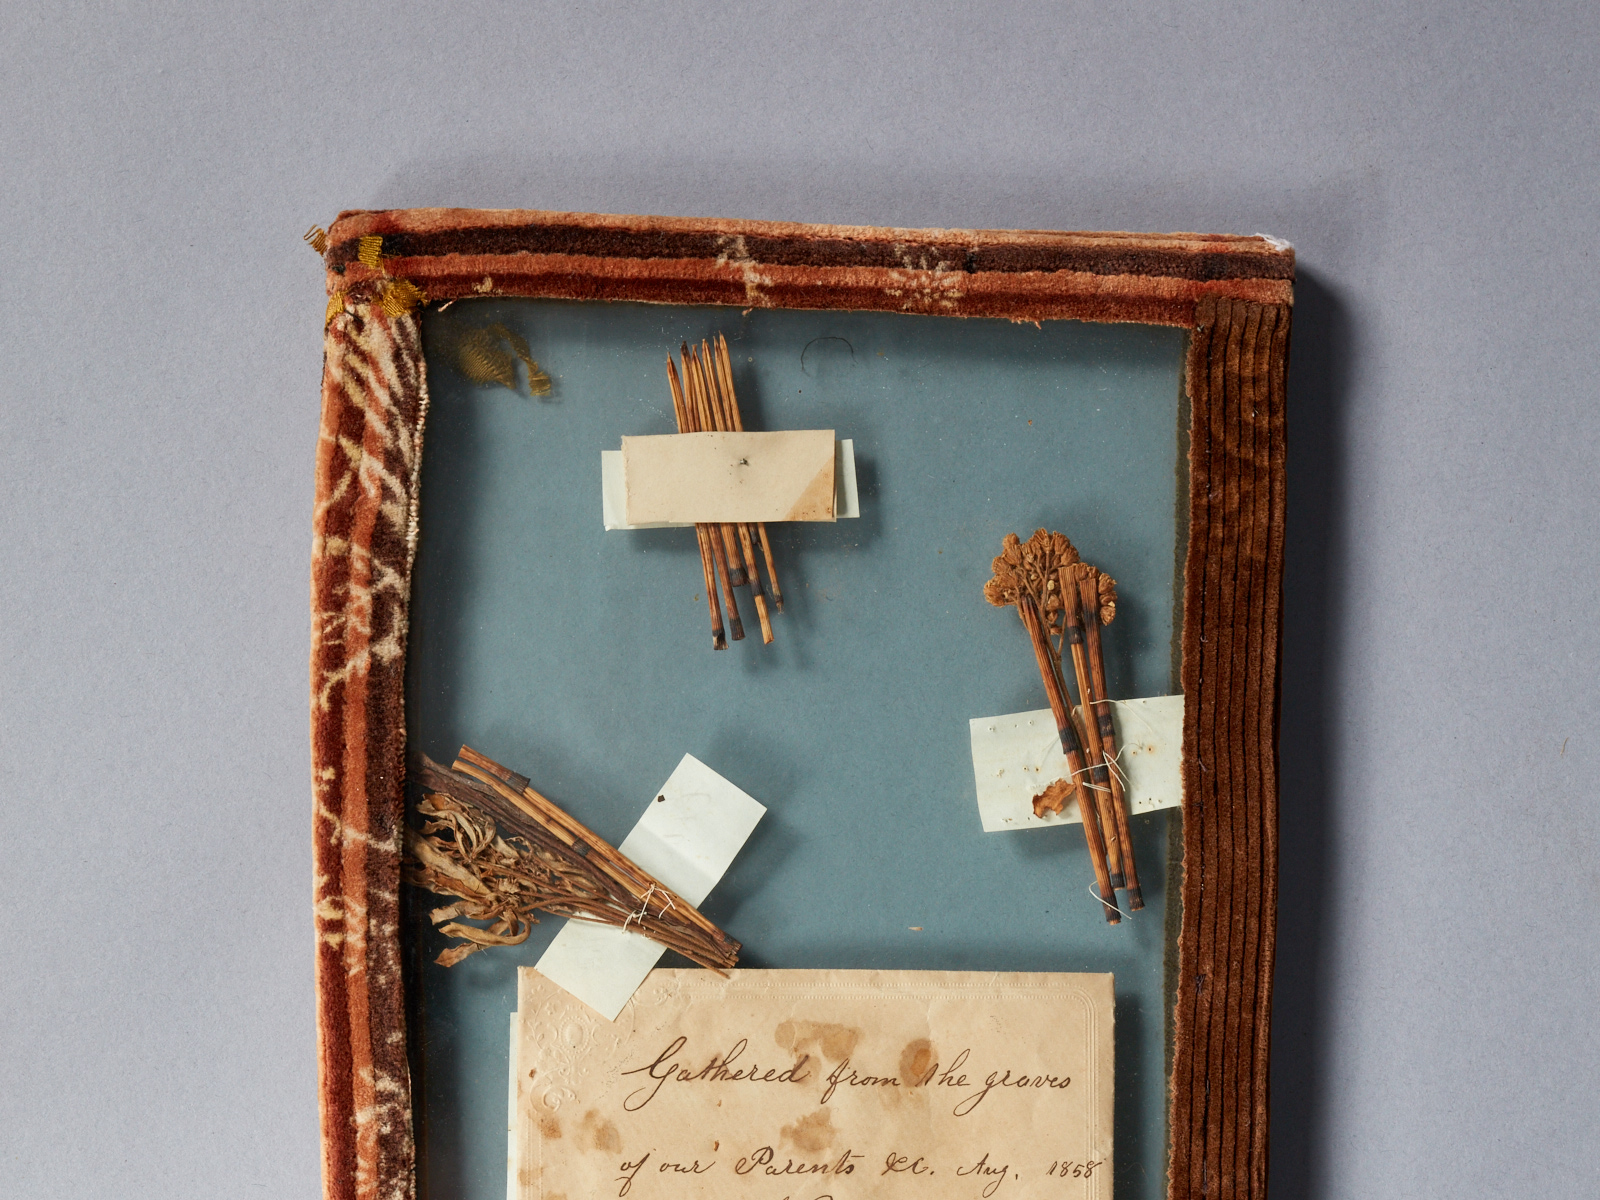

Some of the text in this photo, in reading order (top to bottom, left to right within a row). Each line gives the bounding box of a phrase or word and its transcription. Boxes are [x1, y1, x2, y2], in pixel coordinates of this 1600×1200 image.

[621, 1035, 1072, 1117] Gathered from the graves
[614, 1152, 651, 1198] of
[659, 1160, 717, 1174] our
[734, 1145, 865, 1176] Parents
[1046, 1160, 1103, 1179] 1858
